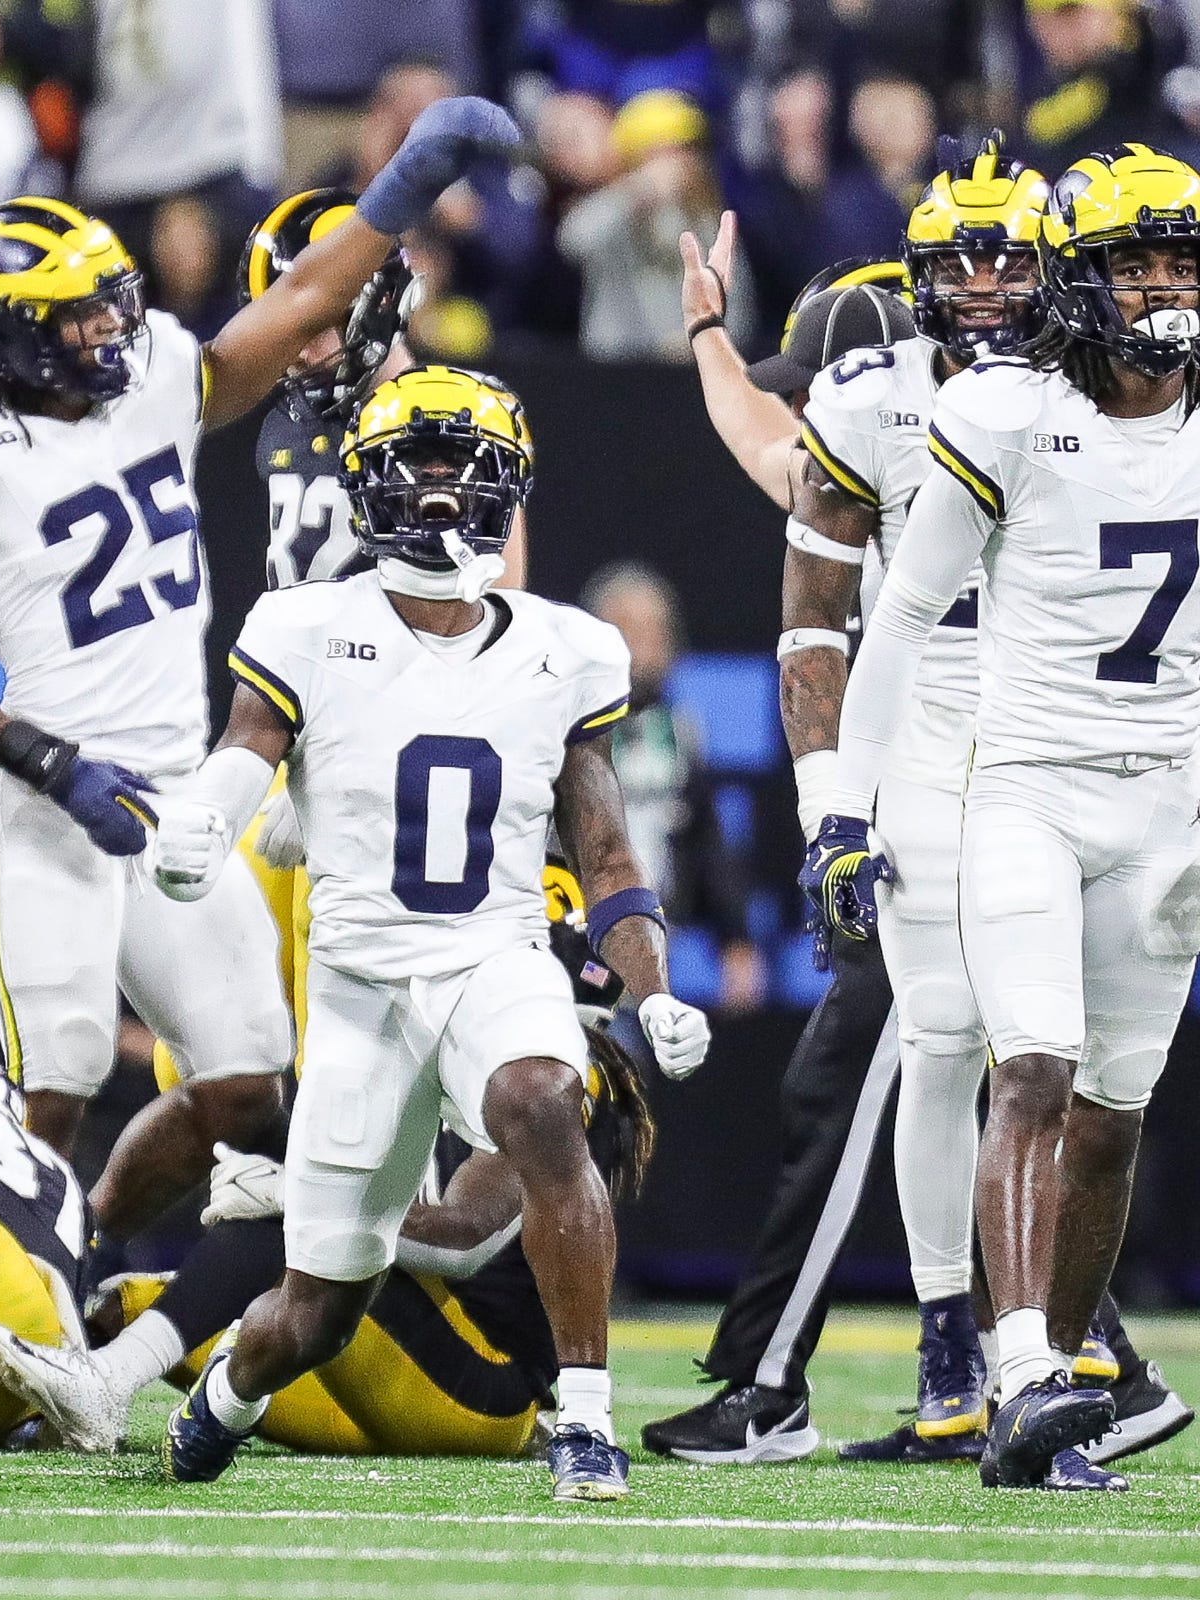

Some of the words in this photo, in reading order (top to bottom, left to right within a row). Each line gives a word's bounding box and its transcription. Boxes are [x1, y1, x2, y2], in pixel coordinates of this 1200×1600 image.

[38, 441, 200, 650] 25
[1096, 519, 1199, 684] 7
[390, 734, 502, 914] 0
